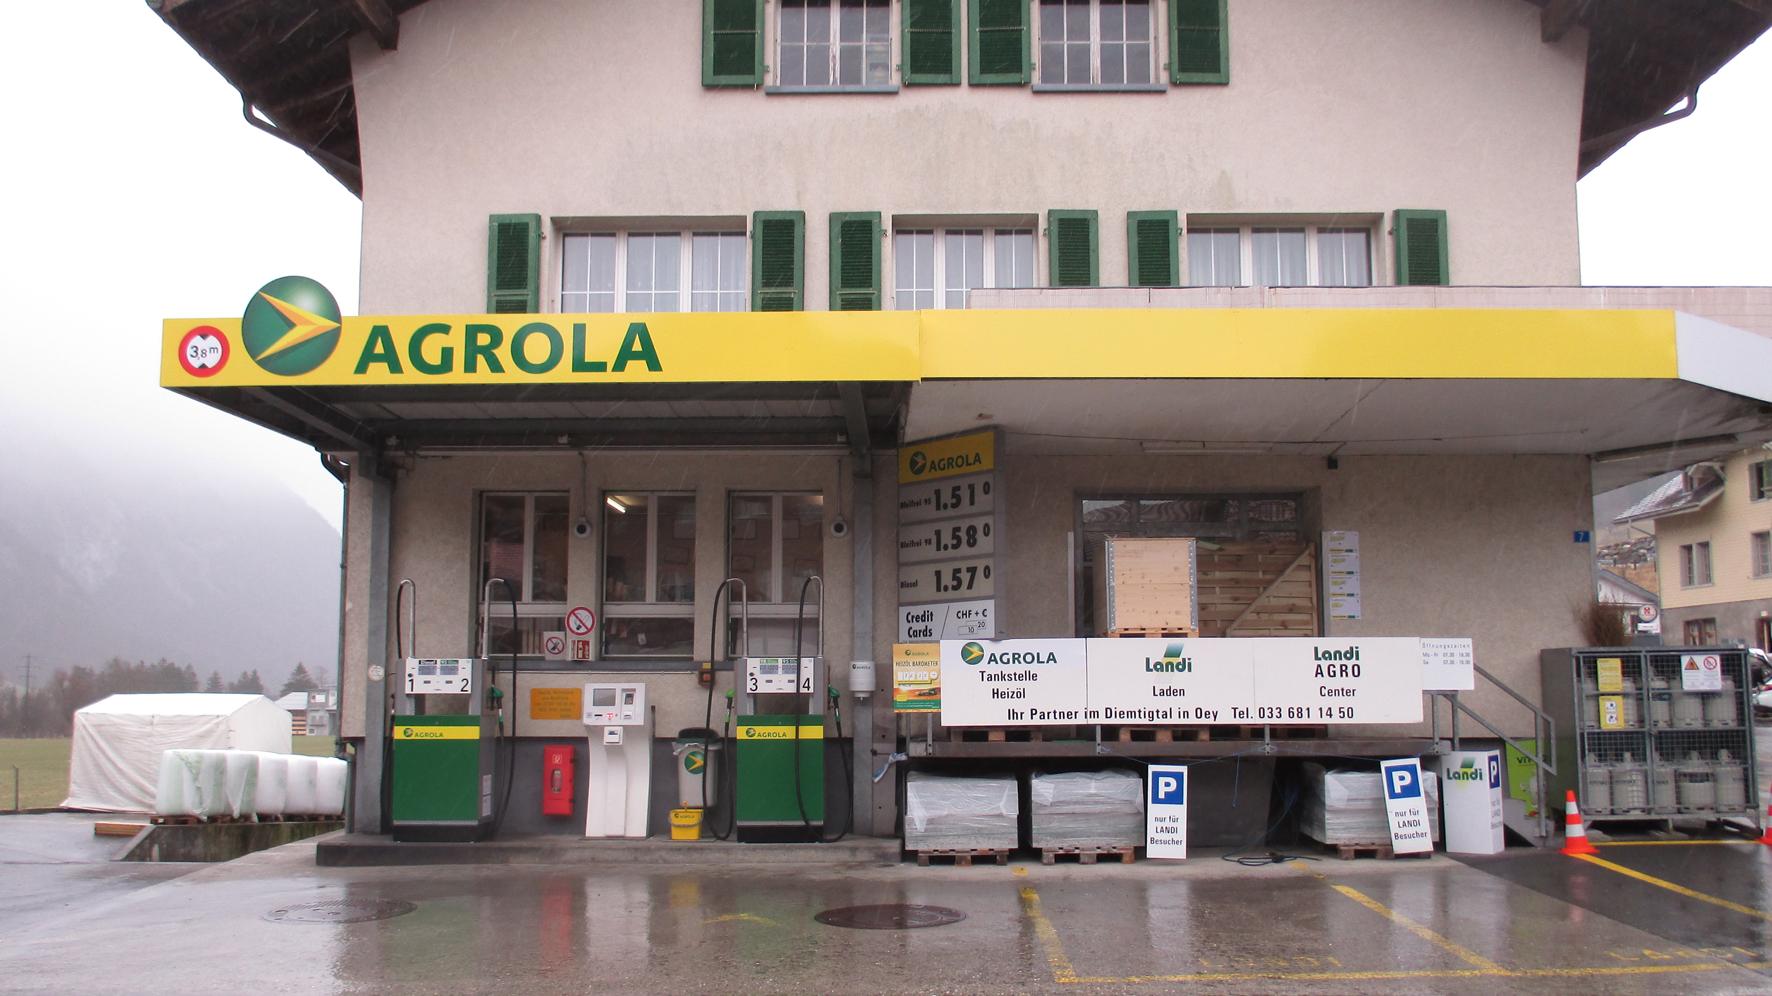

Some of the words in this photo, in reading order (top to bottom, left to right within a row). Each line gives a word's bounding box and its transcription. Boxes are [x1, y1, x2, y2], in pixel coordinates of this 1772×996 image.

[353, 322, 663, 375] AGROLA
[928, 452, 982, 473] AGROLA
[1578, 533, 1584, 541] 7
[906, 610, 934, 624] Credit
[956, 609, 972, 619] CHF
[907, 625, 933, 638] Cards
[987, 651, 1057, 665] AGROLA
[1314, 646, 1360, 661] Landi
[1145, 657, 1192, 673] Landi
[1314, 664, 1361, 678] AGRO
[979, 670, 1038, 682] Tankstelle
[408, 679, 414, 692] 1
[460, 678, 469, 692] 2
[749, 678, 758, 691] 3
[802, 677, 811, 691] 4
[992, 687, 1026, 699] Heizöl
[1152, 686, 1185, 697] Laden
[1319, 686, 1356, 697] Center
[1007, 709, 1025, 720] Ihr
[1030, 708, 1078, 720] Partner
[1084, 708, 1099, 719] im
[1105, 707, 1173, 722] Diemtigtal
[1177, 707, 1189, 719] in
[1195, 707, 1219, 722] Oey
[1231, 707, 1254, 719] Tel.
[1258, 707, 1282, 719] 033
[1288, 707, 1311, 719] 681
[1318, 707, 1333, 719] 14
[1338, 707, 1354, 719] 50
[1446, 768, 1483, 781] Landi
[1408, 808, 1420, 817] für
[1169, 815, 1179, 823] für
[1397, 820, 1421, 829] LANDI
[1155, 826, 1178, 834] LANDI
[1393, 831, 1428, 841] Besucher
[1150, 837, 1183, 845] Besucher
